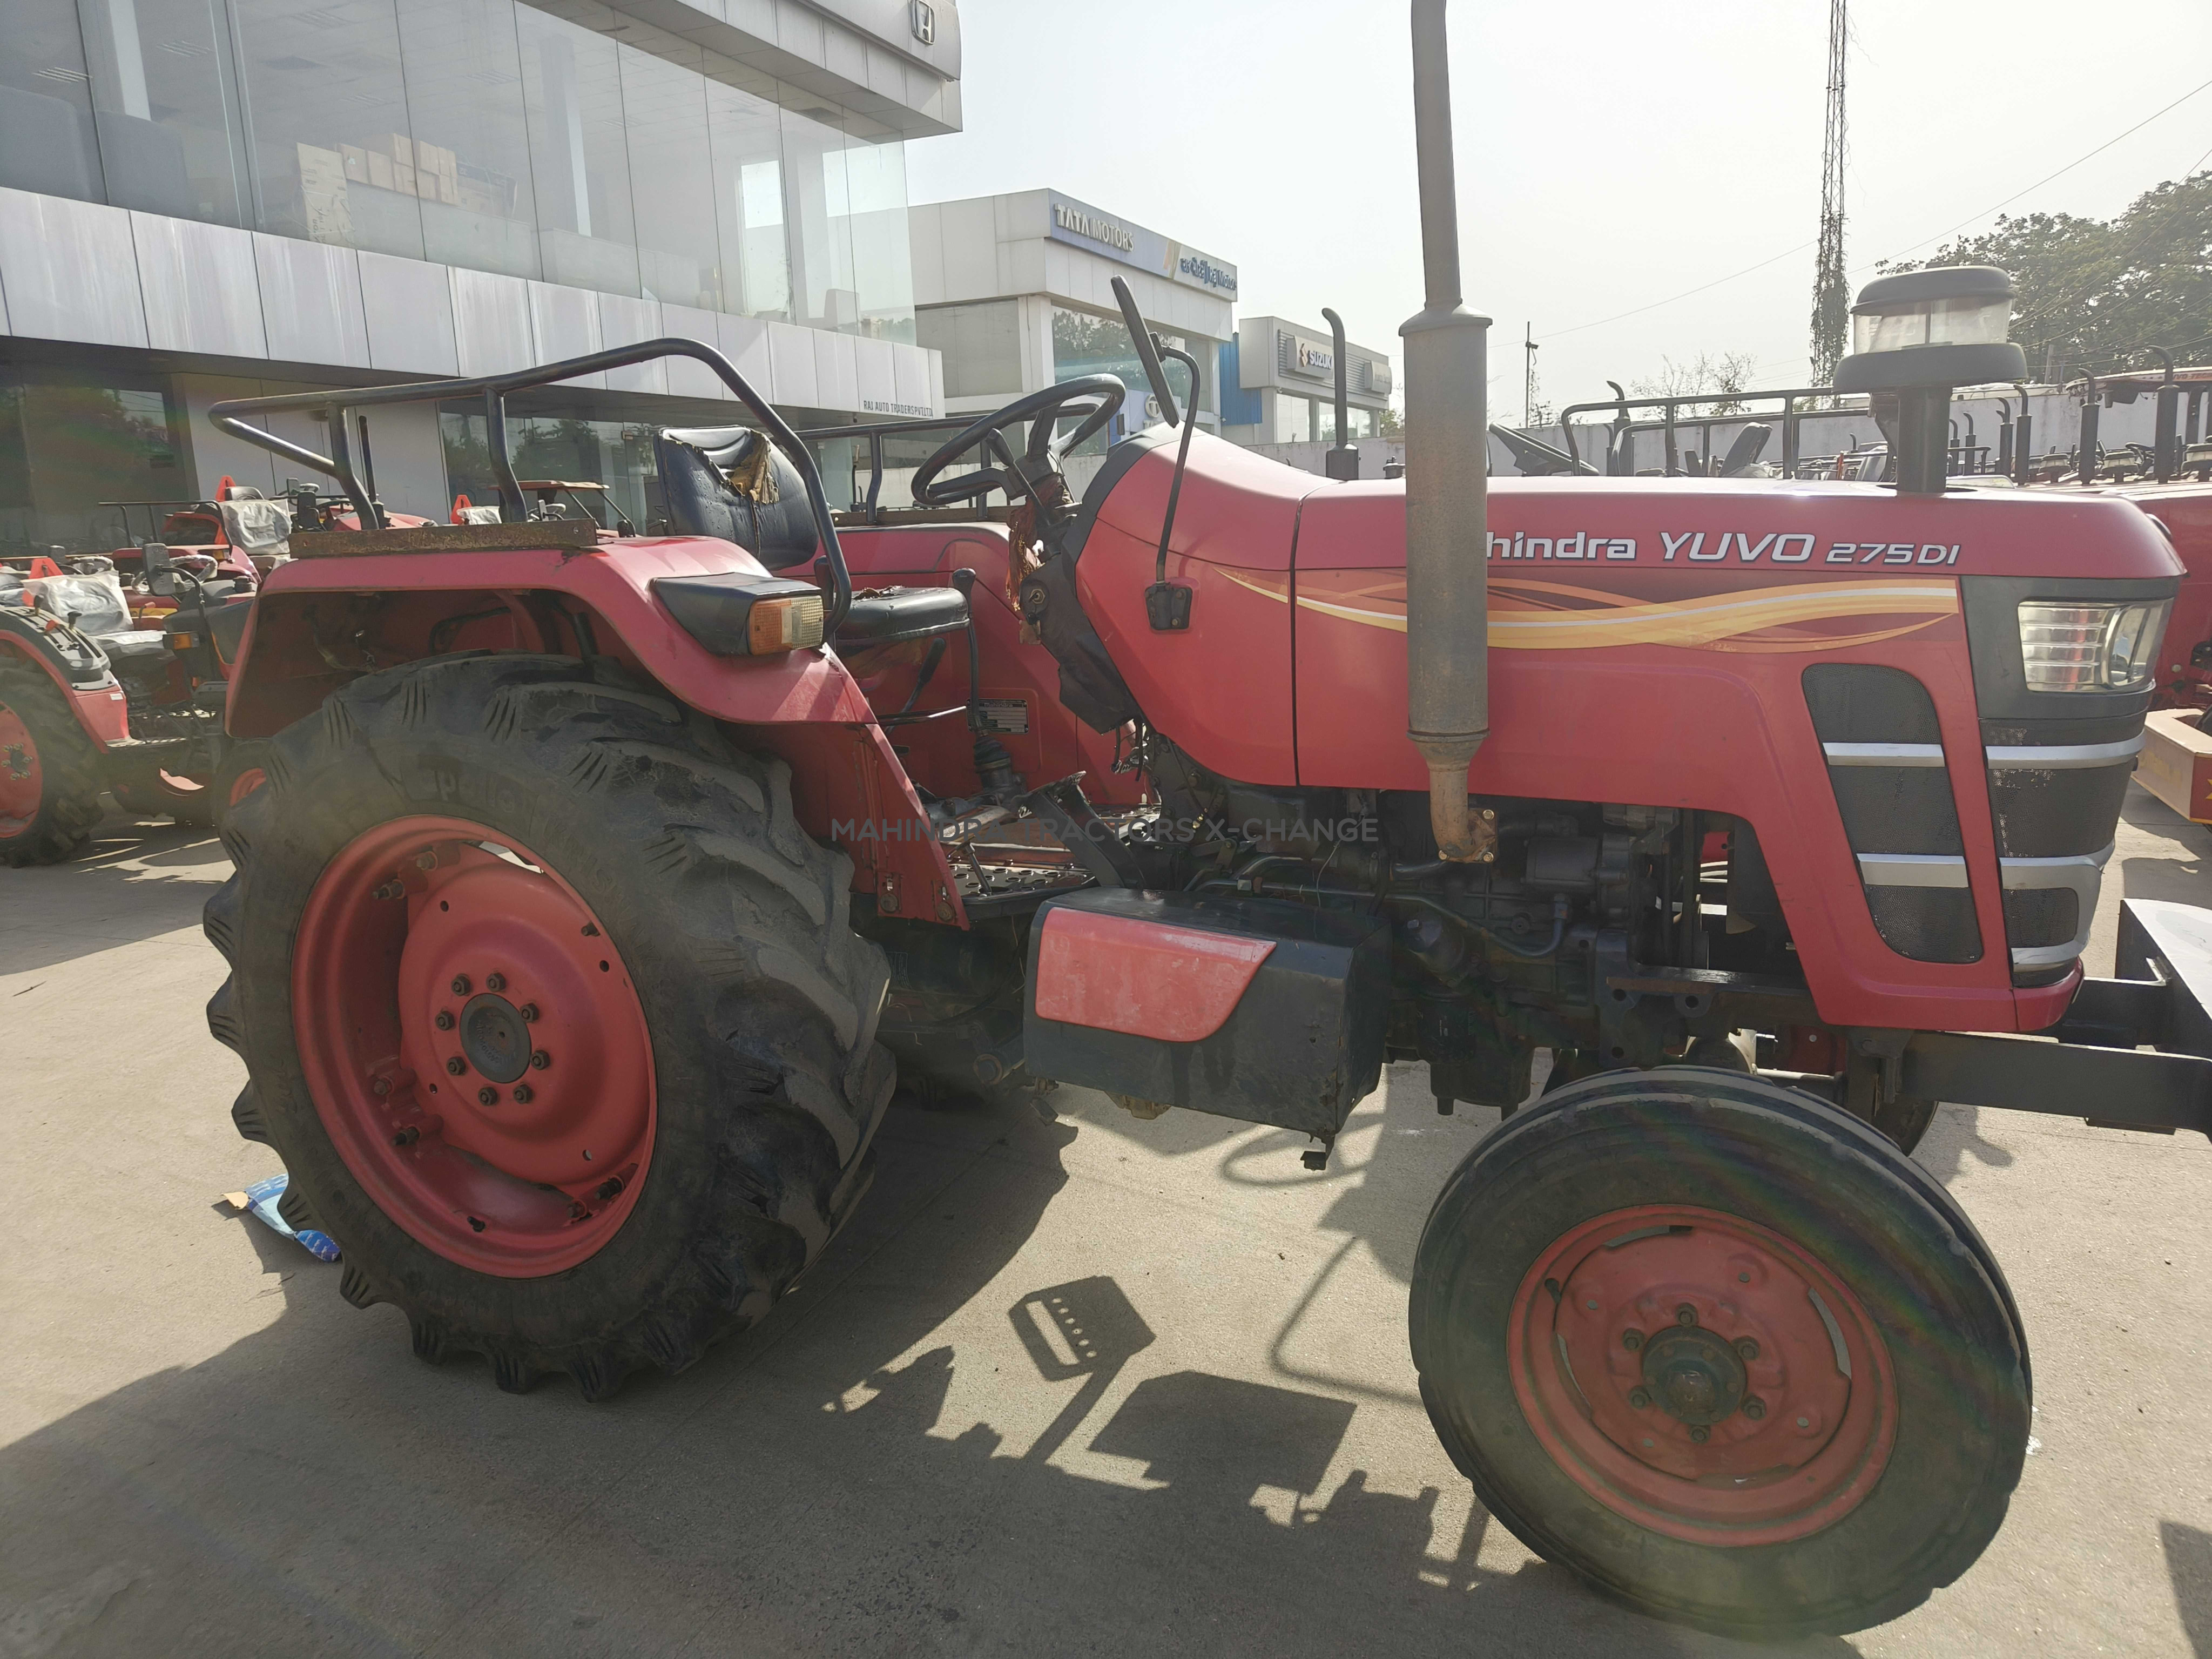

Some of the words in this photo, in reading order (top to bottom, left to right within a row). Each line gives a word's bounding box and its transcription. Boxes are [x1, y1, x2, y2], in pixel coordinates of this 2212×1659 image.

[1054, 203, 1090, 237] TATA
[1090, 217, 1134, 252] MOTORS
[1308, 350, 1333, 370] SUZUKI
[864, 401, 873, 410] RAJ
[875, 402, 889, 412] AUTO
[1487, 531, 1637, 559] hindra
[1660, 531, 1816, 562] YUVO
